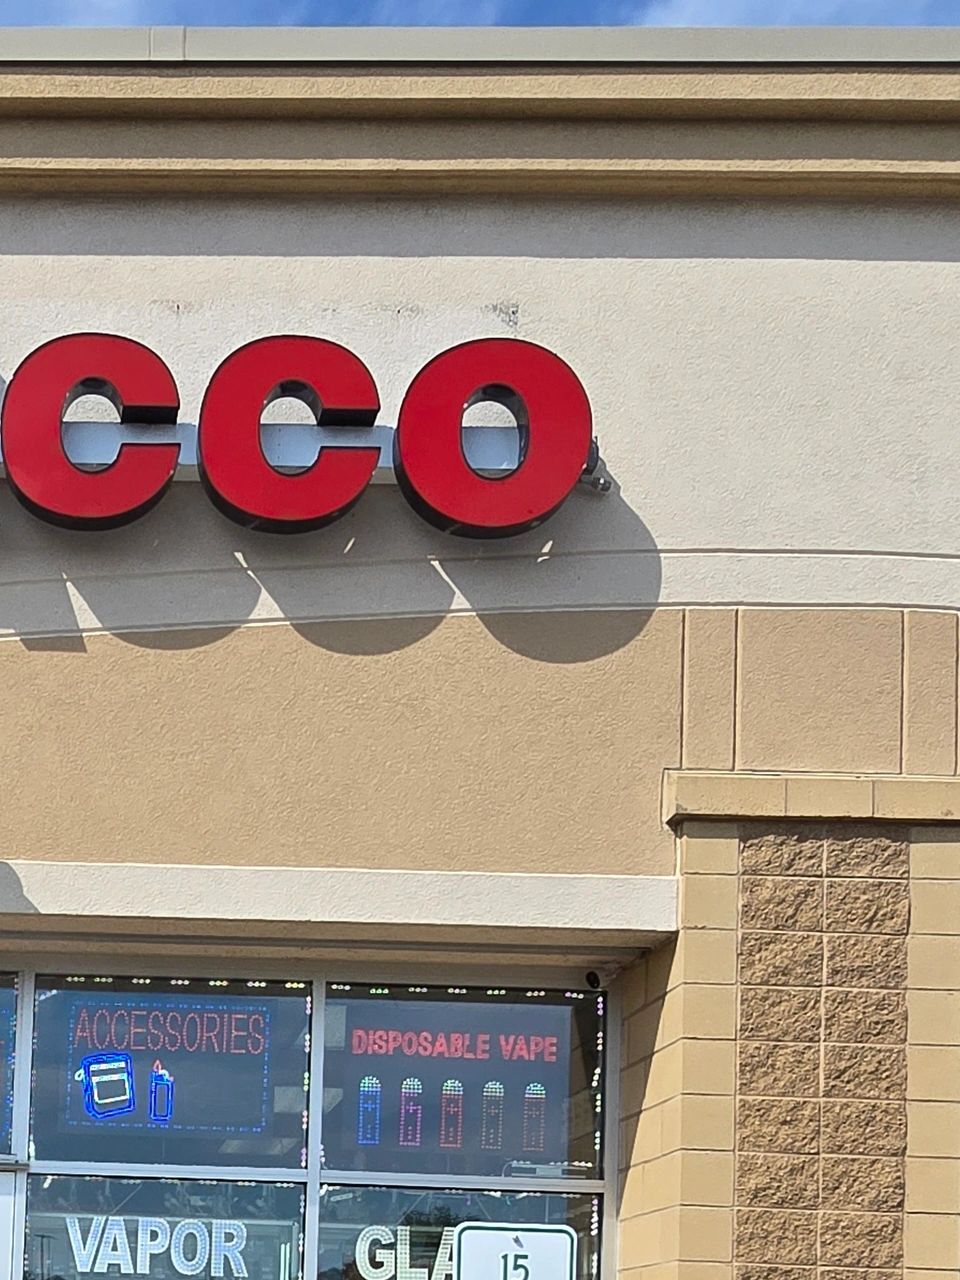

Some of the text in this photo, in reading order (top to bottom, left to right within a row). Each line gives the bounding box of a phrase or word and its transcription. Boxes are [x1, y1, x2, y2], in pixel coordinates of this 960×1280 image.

[74, 1008, 266, 1056] ACCESSORIES
[351, 1028, 558, 1062] DISPOSABLE VAPE
[66, 1216, 248, 1278] VAPOR
